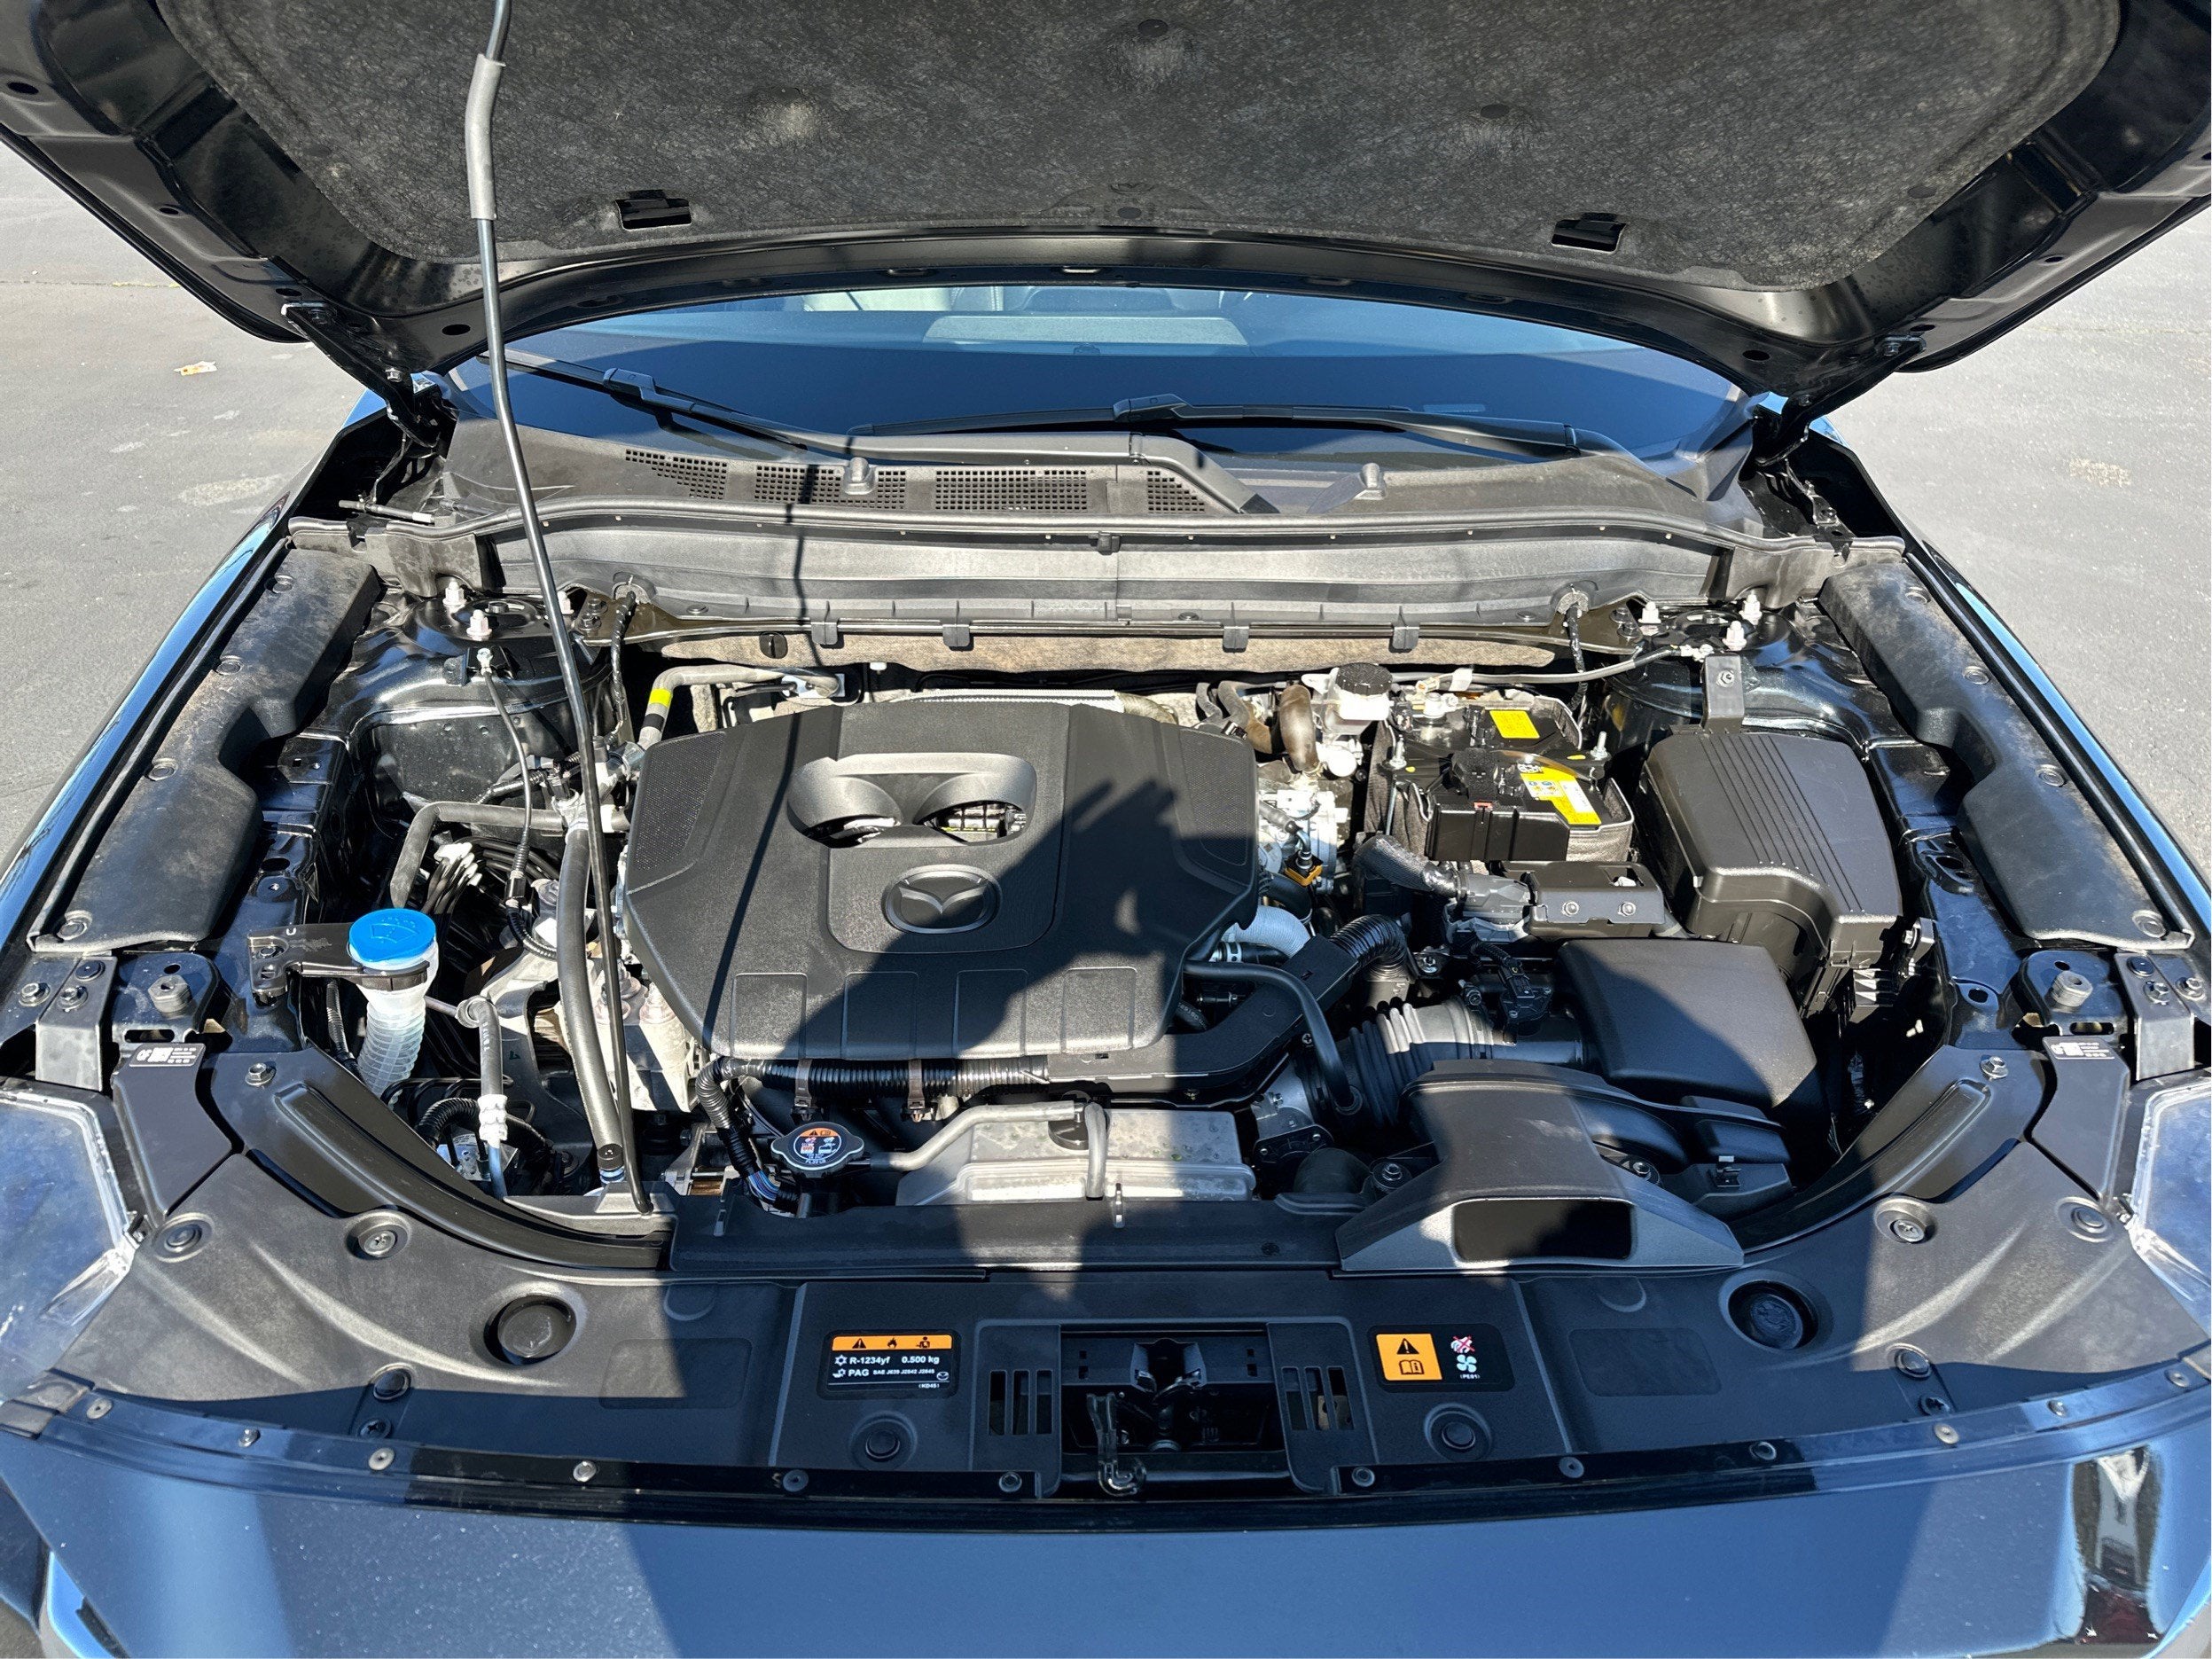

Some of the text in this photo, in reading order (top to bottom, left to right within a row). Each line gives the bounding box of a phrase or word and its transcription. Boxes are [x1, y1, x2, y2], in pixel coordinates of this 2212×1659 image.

[849, 1356, 891, 1366] R-1234yf
[928, 1356, 940, 1366] kg
[848, 1368, 870, 1377] PAG
